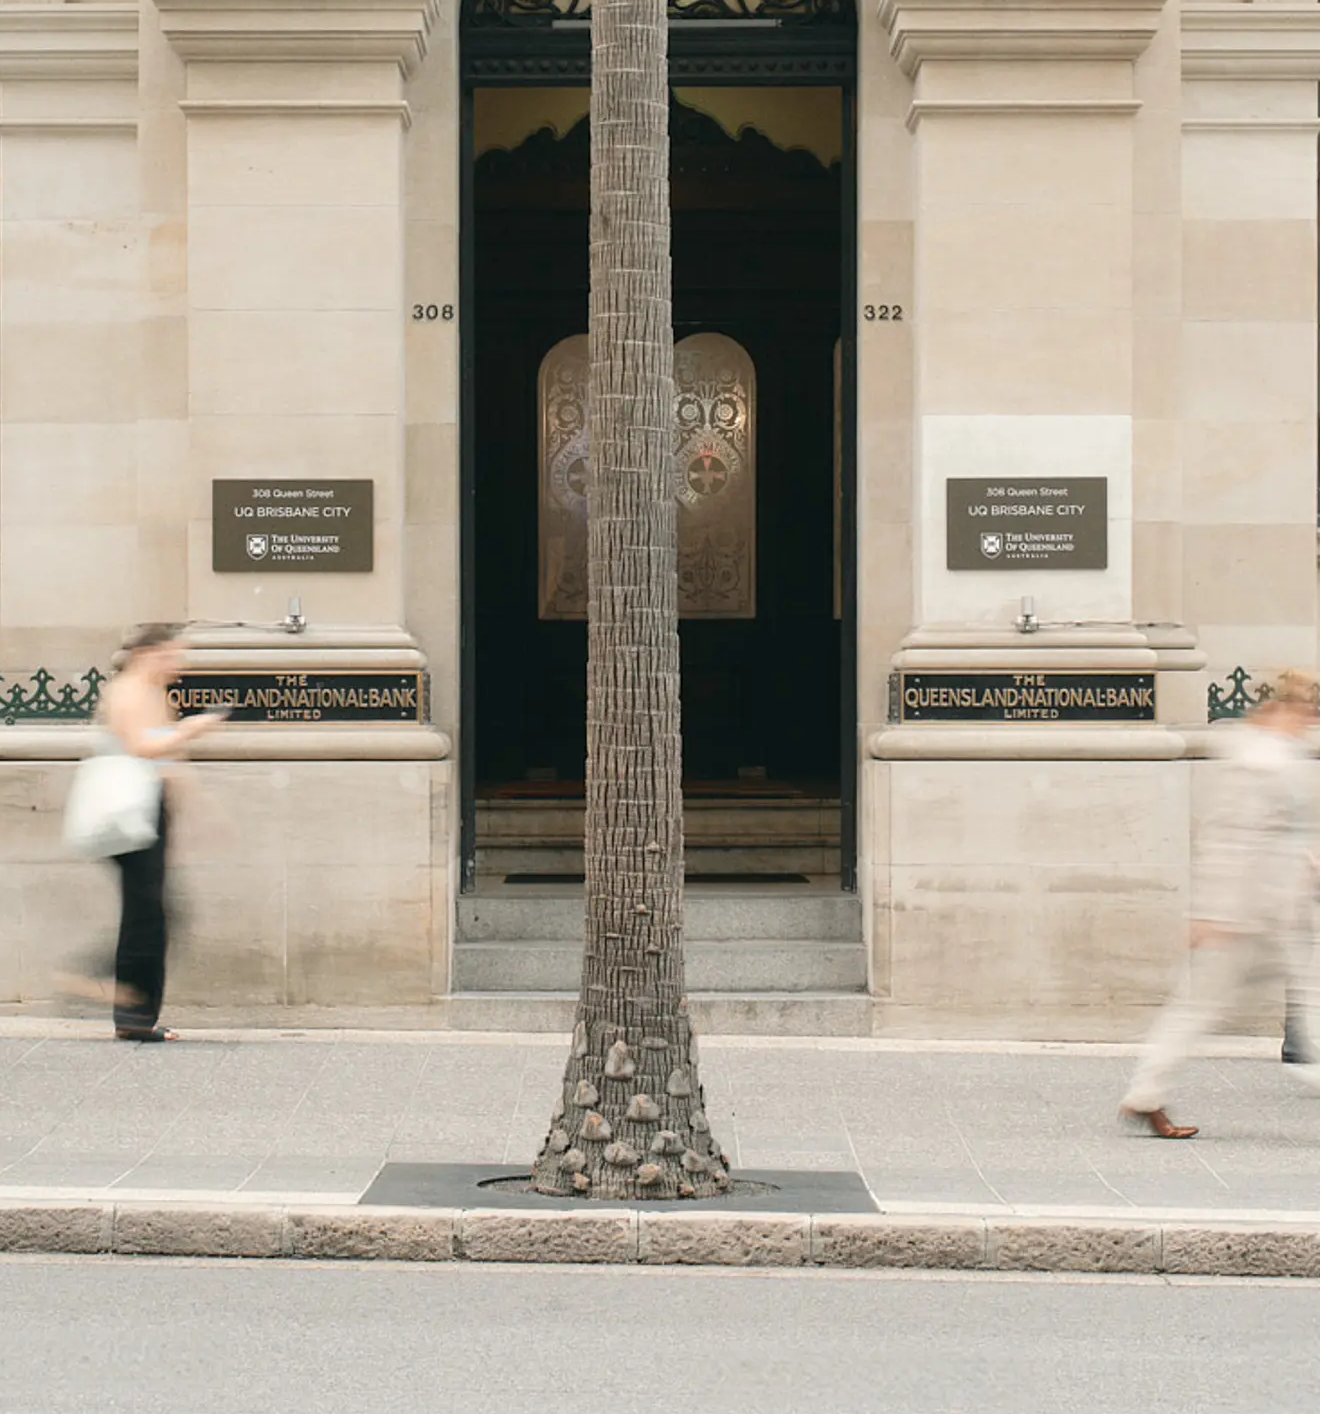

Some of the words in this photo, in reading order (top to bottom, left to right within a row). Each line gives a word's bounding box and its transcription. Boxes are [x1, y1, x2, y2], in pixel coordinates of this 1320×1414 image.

[412, 304, 454, 321] 308
[863, 304, 903, 321] 322
[252, 488, 271, 498] 308
[273, 488, 303, 498] Queen
[306, 488, 334, 498] Street
[986, 487, 1005, 497] 308
[1007, 487, 1038, 497] Queen
[1040, 487, 1068, 497] Street
[234, 507, 254, 518] UQ
[257, 507, 319, 518] BRISBANE
[322, 507, 352, 518] CITY
[968, 505, 988, 516] UQ
[991, 505, 1053, 516] BRISBANE
[1056, 505, 1085, 516] CITY
[271, 534, 288, 543] THE
[290, 534, 340, 544] UNIVERSITY
[1005, 532, 1022, 541] THE
[1025, 532, 1074, 542] UNIVERSITY
[271, 544, 283, 553] OF
[285, 544, 340, 554] QUEENSLAND
[1005, 542, 1017, 551] OF
[1019, 542, 1075, 552] QUEENSLAND
[276, 675, 308, 686] THE
[1013, 675, 1046, 686] THE
[266, 709, 322, 720] LIMITED
[1004, 709, 1060, 719] LIMITED
